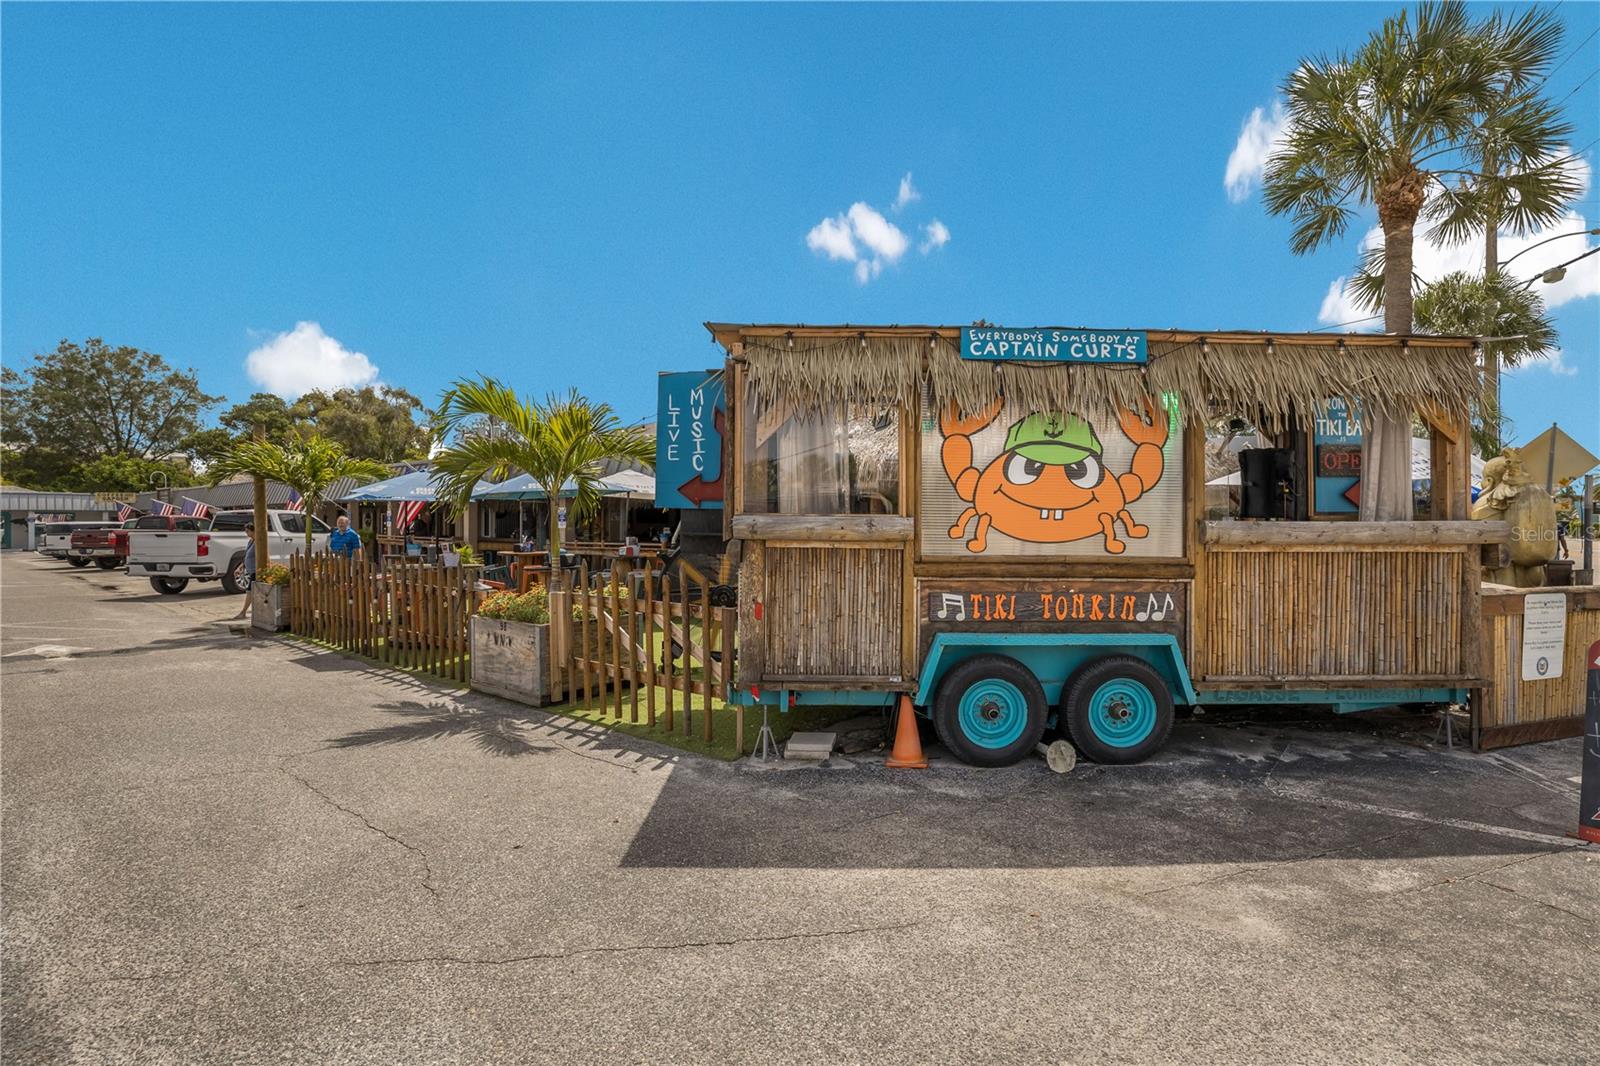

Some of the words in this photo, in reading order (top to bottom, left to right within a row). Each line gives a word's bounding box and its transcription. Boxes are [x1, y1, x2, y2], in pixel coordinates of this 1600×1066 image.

[1052, 331, 1121, 344] SOMEBODY
[1125, 335, 1140, 345] AT
[970, 341, 1058, 357] CAPTAIN
[667, 393, 681, 461] LIVE
[690, 388, 706, 471] MUSIC
[1317, 419, 1342, 436] TIKI
[1346, 419, 1363, 436] BA
[1325, 453, 1361, 470] OPE
[970, 593, 1017, 621] TIKI
[1040, 593, 1137, 621] TONKIN
